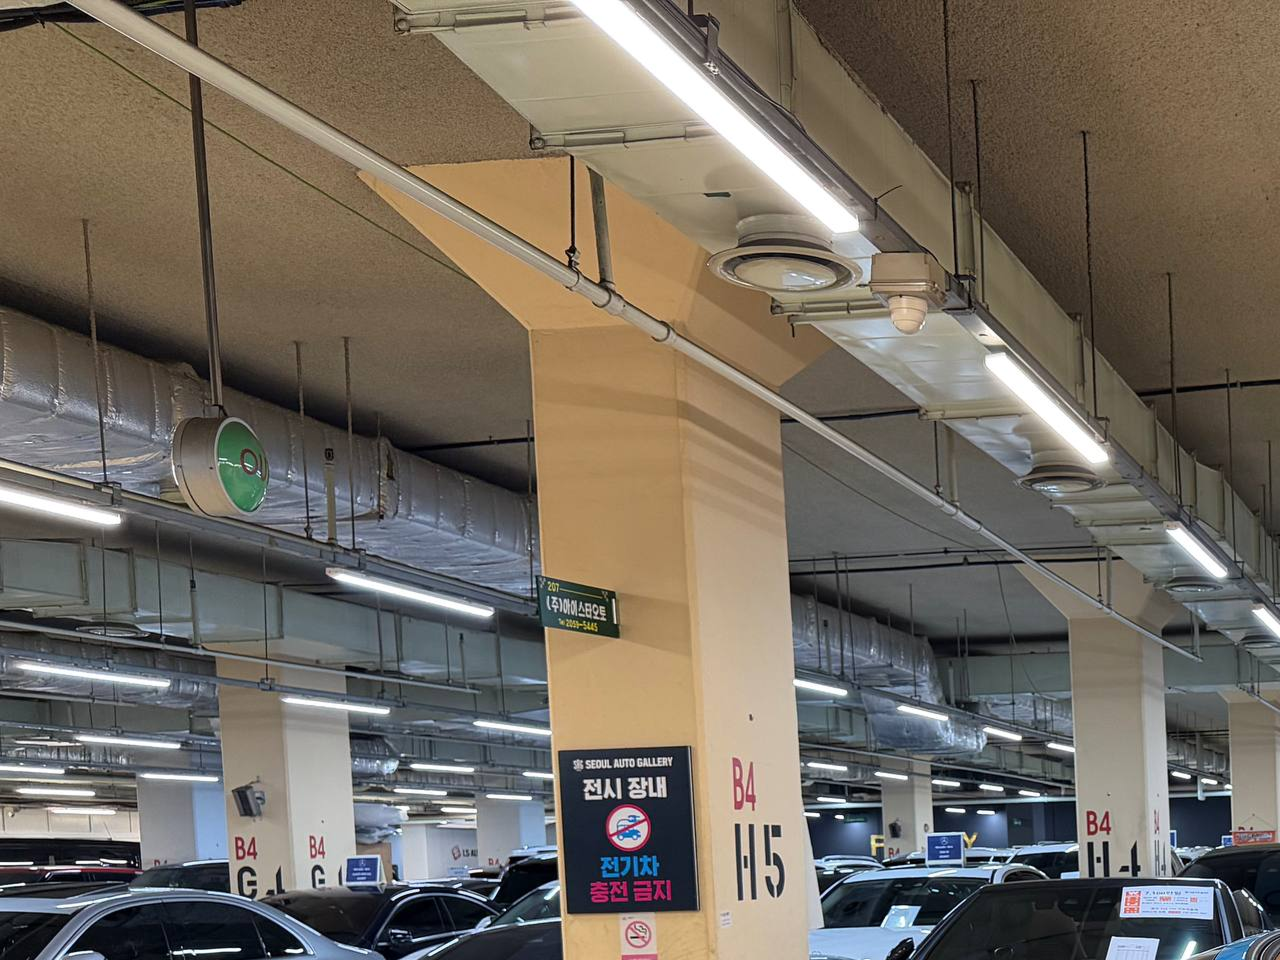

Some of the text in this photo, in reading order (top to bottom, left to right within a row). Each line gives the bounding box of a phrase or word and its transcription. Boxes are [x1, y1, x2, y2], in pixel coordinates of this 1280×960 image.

[547, 581, 560, 592] 207
[546, 595, 607, 621] (주)아이스타오토
[566, 619, 598, 632] 2059-5445
[585, 756, 673, 770] SEOUL AUTO GALLERY
[583, 776, 668, 801] 전시 장내
[732, 757, 756, 811] B4
[1086, 810, 1111, 836] B4
[234, 837, 257, 861] B4
[309, 835, 325, 859] B4
[1086, 840, 1141, 878] H4
[600, 855, 660, 879] 전기차
[734, 823, 785, 901] H5
[590, 880, 672, 903] 충전 금지
